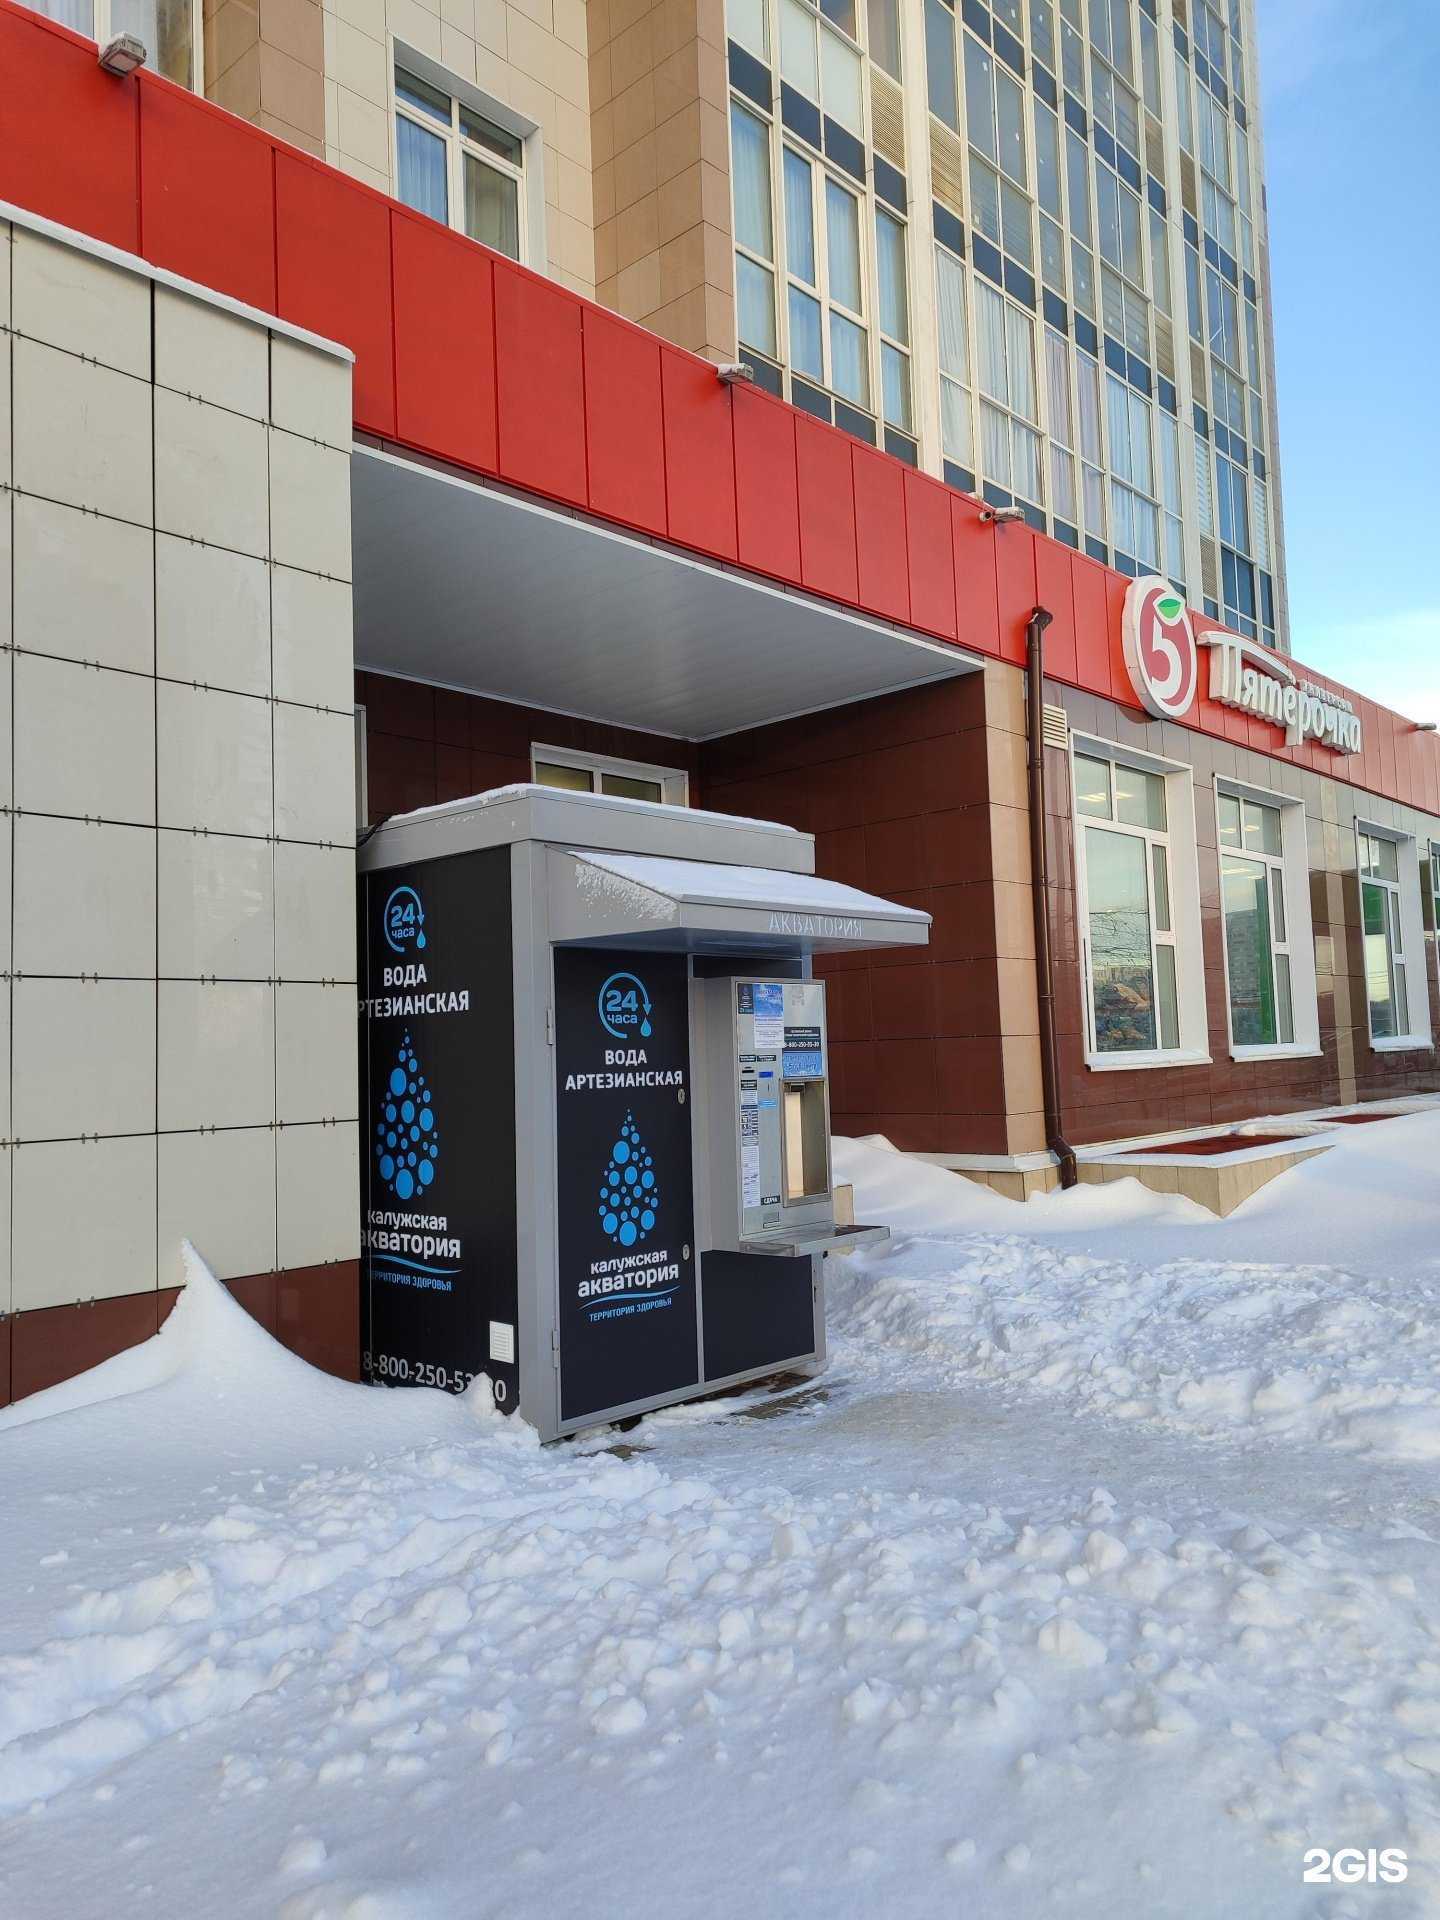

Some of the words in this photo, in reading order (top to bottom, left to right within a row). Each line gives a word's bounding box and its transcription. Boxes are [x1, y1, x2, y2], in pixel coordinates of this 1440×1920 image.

[390, 903, 416, 928] 24
[768, 911, 865, 937] АКВАТОРИЯ
[391, 926, 415, 939] часа
[383, 963, 428, 988] ВОДА
[358, 990, 469, 1018] РТЕЗИАНСКАЯ
[606, 990, 638, 1012] 24
[607, 1014, 638, 1024] часа
[604, 1049, 648, 1067] ВОДА
[565, 1070, 683, 1091] АРТЕЗИАНСКАЯ
[367, 1209, 448, 1232] калужская
[590, 1249, 668, 1275] калужская
[412, 1275, 452, 1291] ЗДОРОВЬЯ
[578, 1263, 680, 1297] акватория
[589, 1304, 635, 1323] ТЕРРИТОРИЯ
[636, 1297, 672, 1314] ЗДОРОВЬЯ
